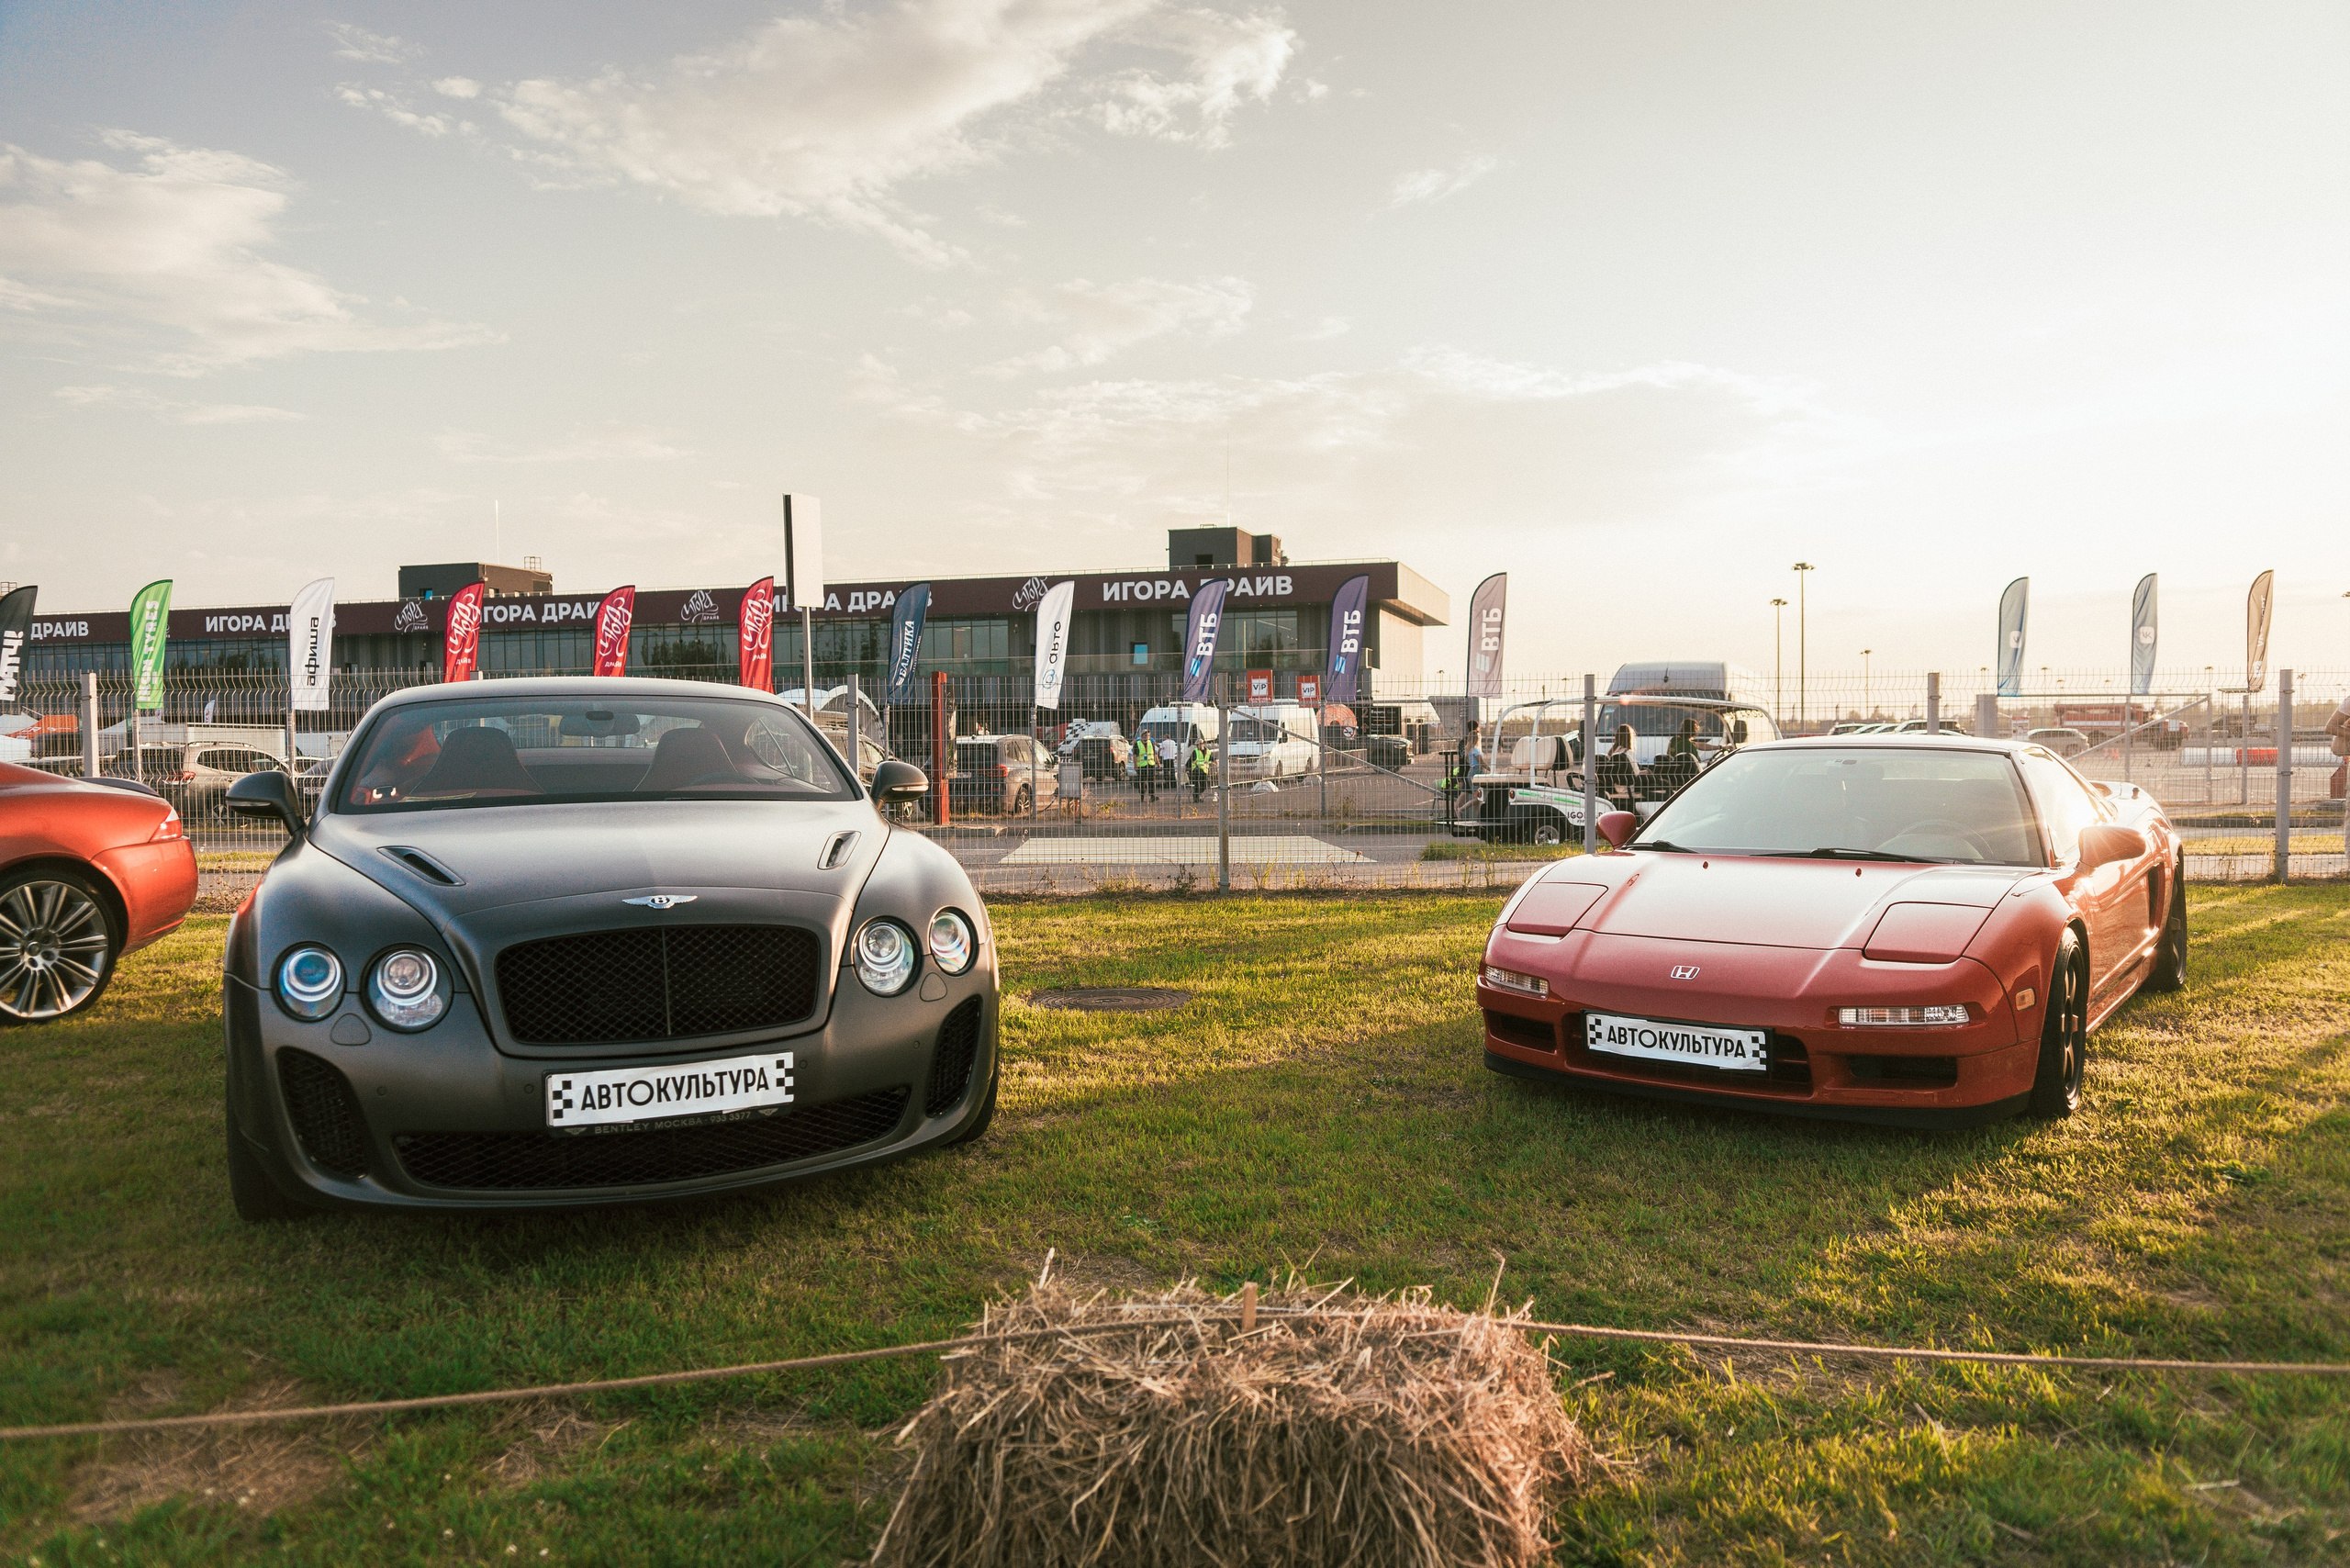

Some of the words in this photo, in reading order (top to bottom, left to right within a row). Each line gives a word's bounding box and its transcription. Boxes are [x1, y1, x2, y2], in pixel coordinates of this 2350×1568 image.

[847, 590, 933, 612] ДРА
[1102, 579, 1191, 601] ИГОРА
[1200, 576, 1293, 597] АЙВ
[30, 621, 89, 640] ДРАЙВ
[143, 599, 159, 655] TYRES
[205, 614, 266, 633] ИГОРА
[480, 605, 537, 622] ГОРА
[542, 600, 600, 623] ДРАЙ
[1340, 610, 1360, 653] ВТБ
[1481, 607, 1502, 651] ВТБ
[305, 617, 319, 686] афиша
[900, 621, 914, 678] БАЛТИКА
[1048, 621, 1061, 664] авто
[1196, 612, 1218, 656] ВТБ
[1607, 1025, 1747, 1058] АВТОКУЛЬТУРА
[581, 1067, 769, 1111] АВТОКУЛЬТУРА
[594, 1123, 649, 1134] BENTLEY
[655, 1117, 703, 1129] МОСКВА
[710, 1114, 727, 1123] 933
[729, 1112, 751, 1121] 3377
